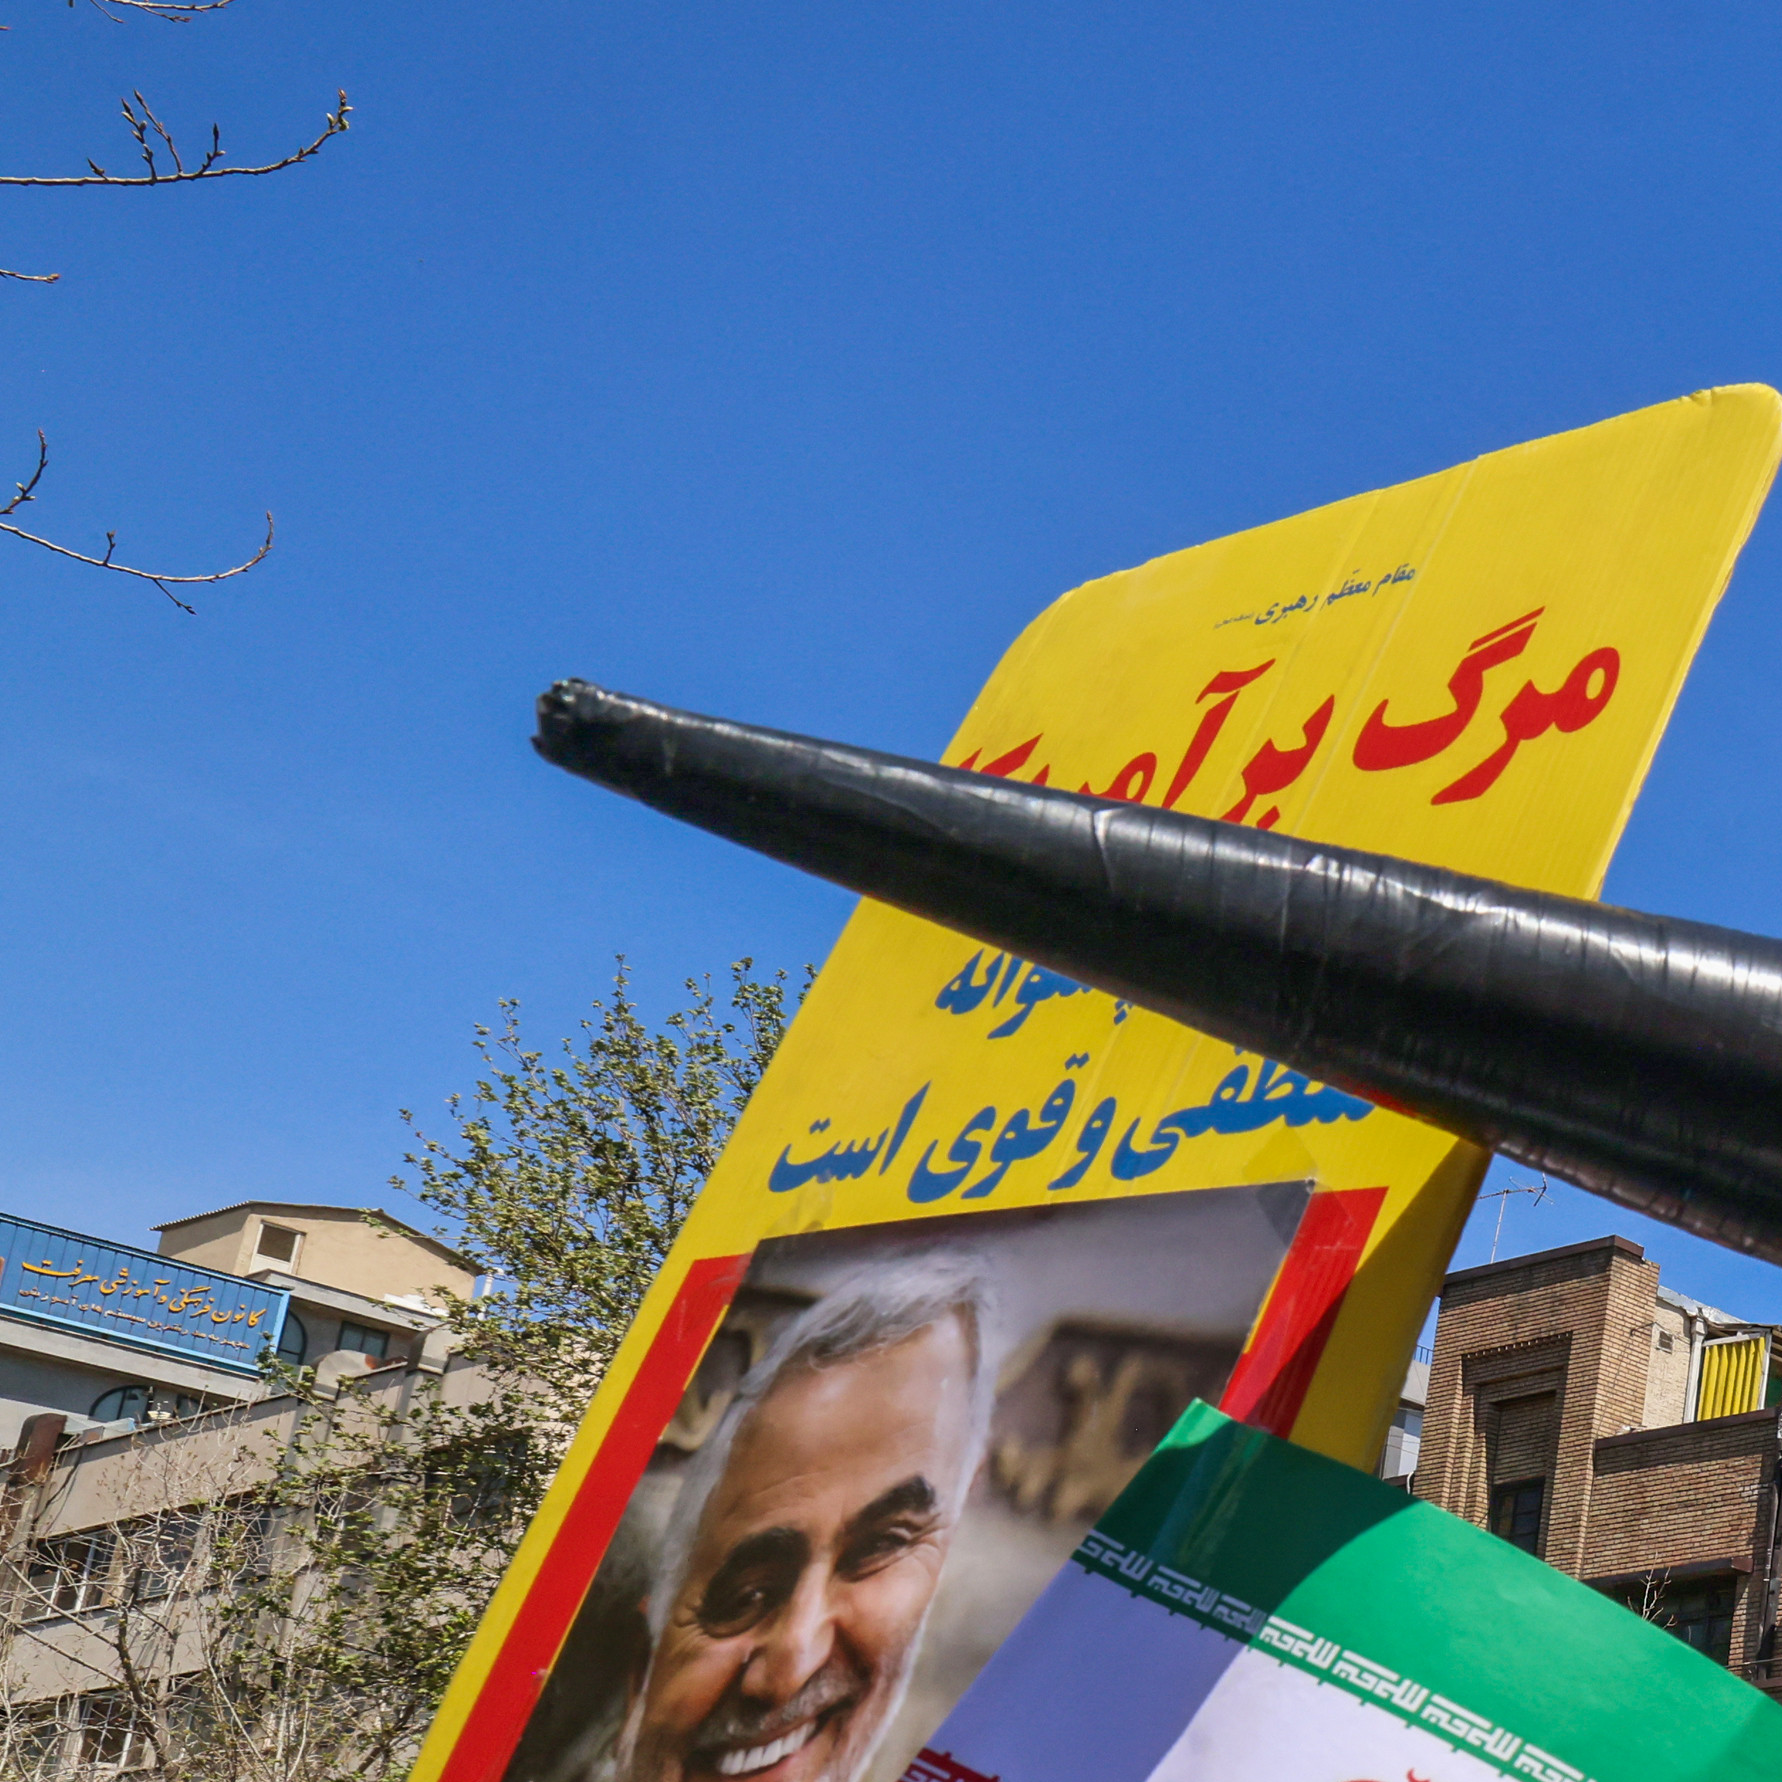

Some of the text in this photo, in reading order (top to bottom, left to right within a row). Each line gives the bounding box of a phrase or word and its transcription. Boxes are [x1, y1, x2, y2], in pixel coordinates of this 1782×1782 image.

[1352, 606, 1620, 805] مرگ
[768, 1080, 932, 1194] است
[906, 1052, 1090, 1204] قوی
[99, 1267, 171, 1299] آموزشی
[168, 1285, 215, 1318] فرهنگی
[211, 1304, 267, 1328] کانون
